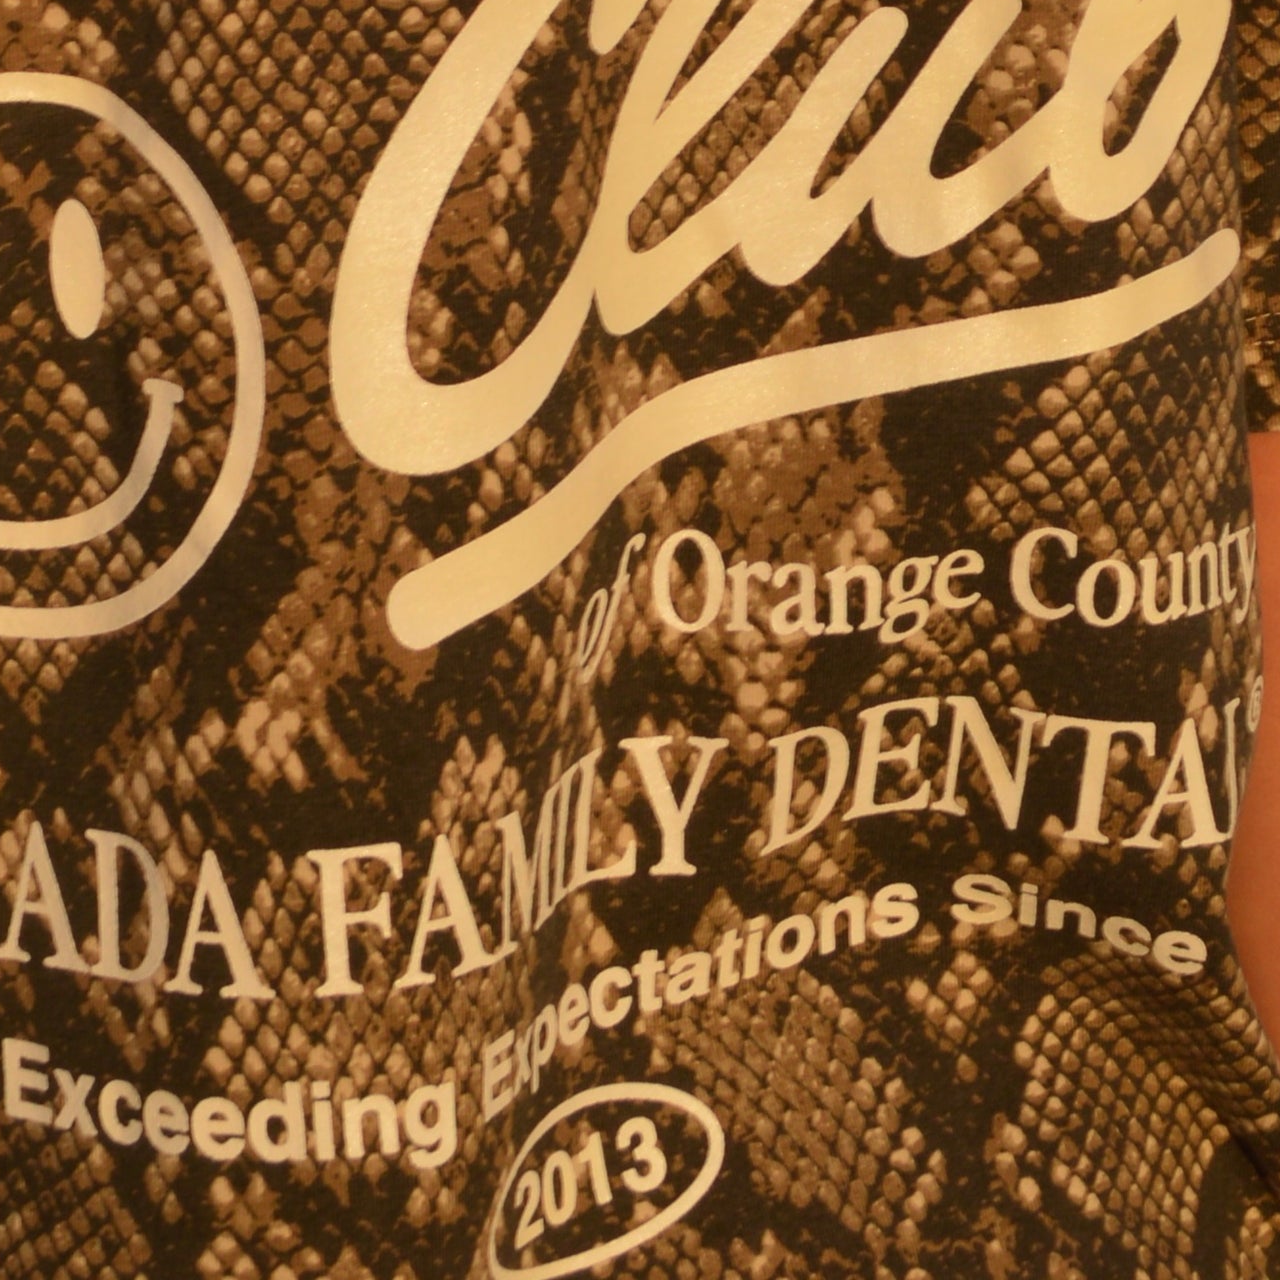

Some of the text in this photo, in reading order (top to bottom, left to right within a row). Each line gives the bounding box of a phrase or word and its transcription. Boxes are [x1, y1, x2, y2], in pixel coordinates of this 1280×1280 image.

[577, 527, 1257, 683] of Orange County
[307, 736, 728, 998] FAMILY
[2, 873, 1208, 1169] Exceeding Expectations Since
[513, 1117, 669, 1250] 2013
